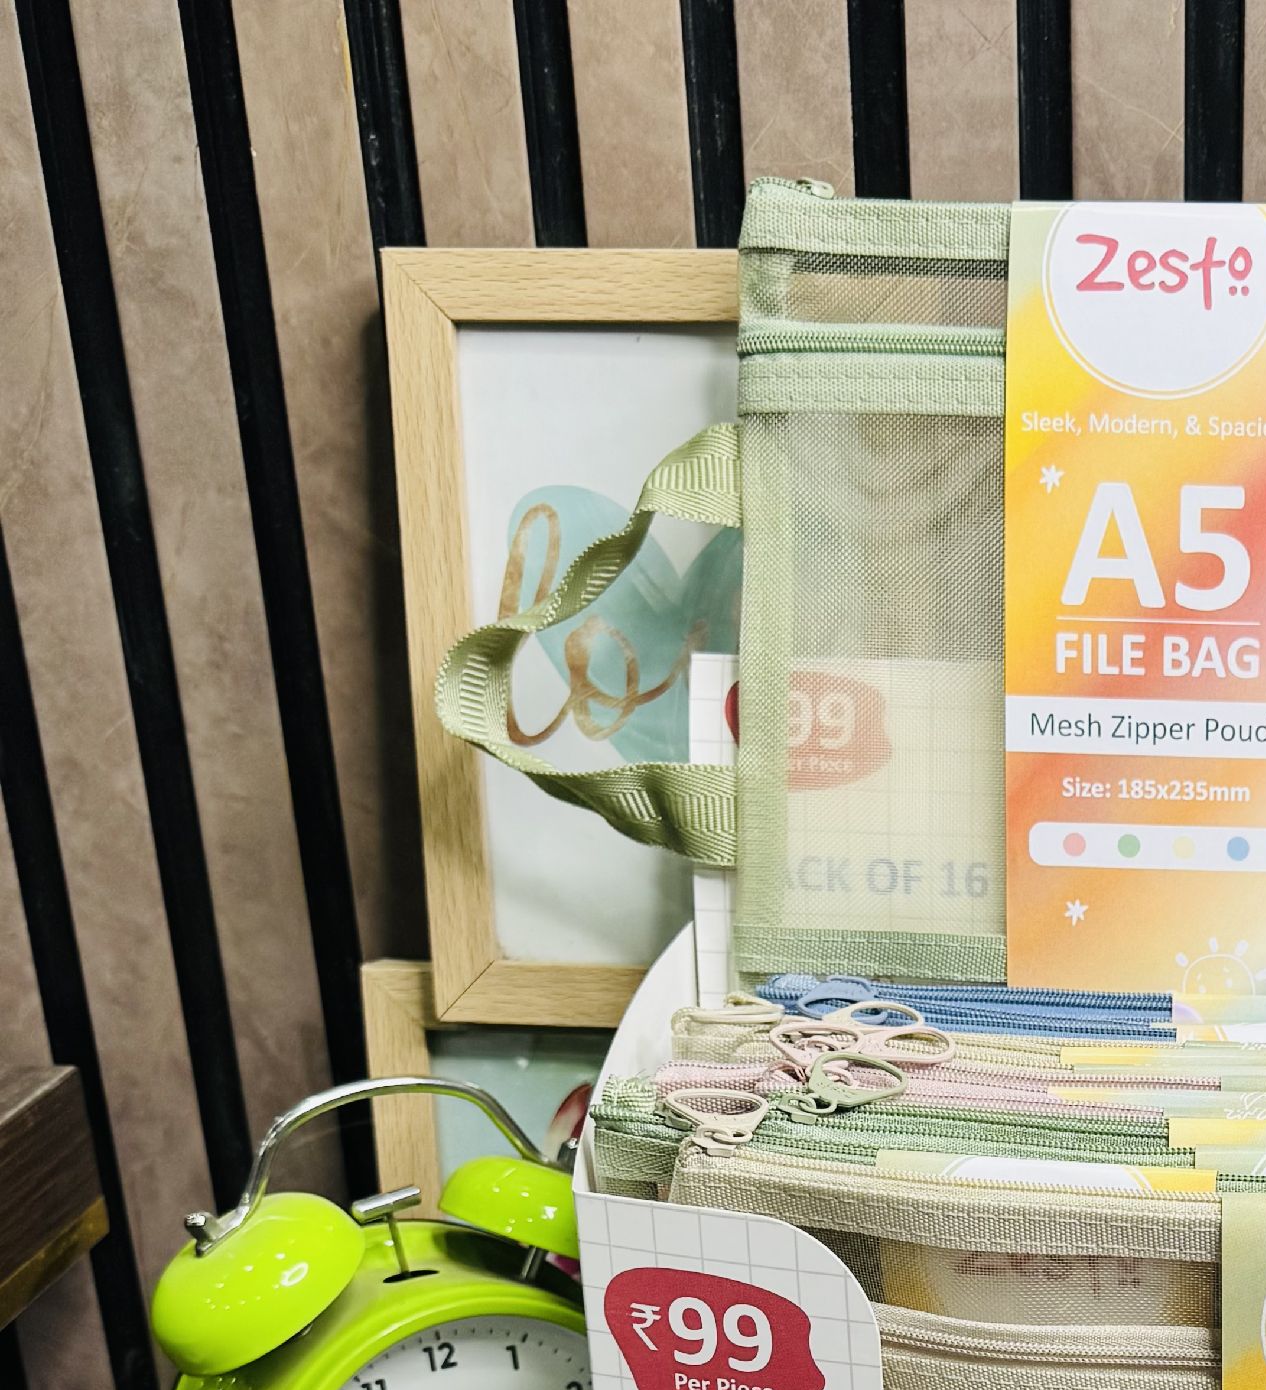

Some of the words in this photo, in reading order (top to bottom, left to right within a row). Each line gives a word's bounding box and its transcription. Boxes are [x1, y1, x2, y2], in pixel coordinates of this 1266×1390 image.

[1075, 234, 1253, 310] Zesto
[1021, 412, 1082, 436] Sleek,
[1089, 414, 1178, 439] Modern,
[1185, 416, 1201, 435] &
[1061, 481, 1251, 612] A5
[1055, 632, 1145, 675] FILE
[1162, 635, 1260, 679] BAG
[1030, 713, 1101, 738] Mesh
[1111, 715, 1195, 745] Zipper
[1062, 777, 1110, 798] Size:
[1117, 779, 1250, 802] 185x235mm
[867, 856, 924, 896] OF
[939, 862, 990, 898] 16
[423, 1343, 458, 1371] 12
[506, 1345, 519, 1370] 1
